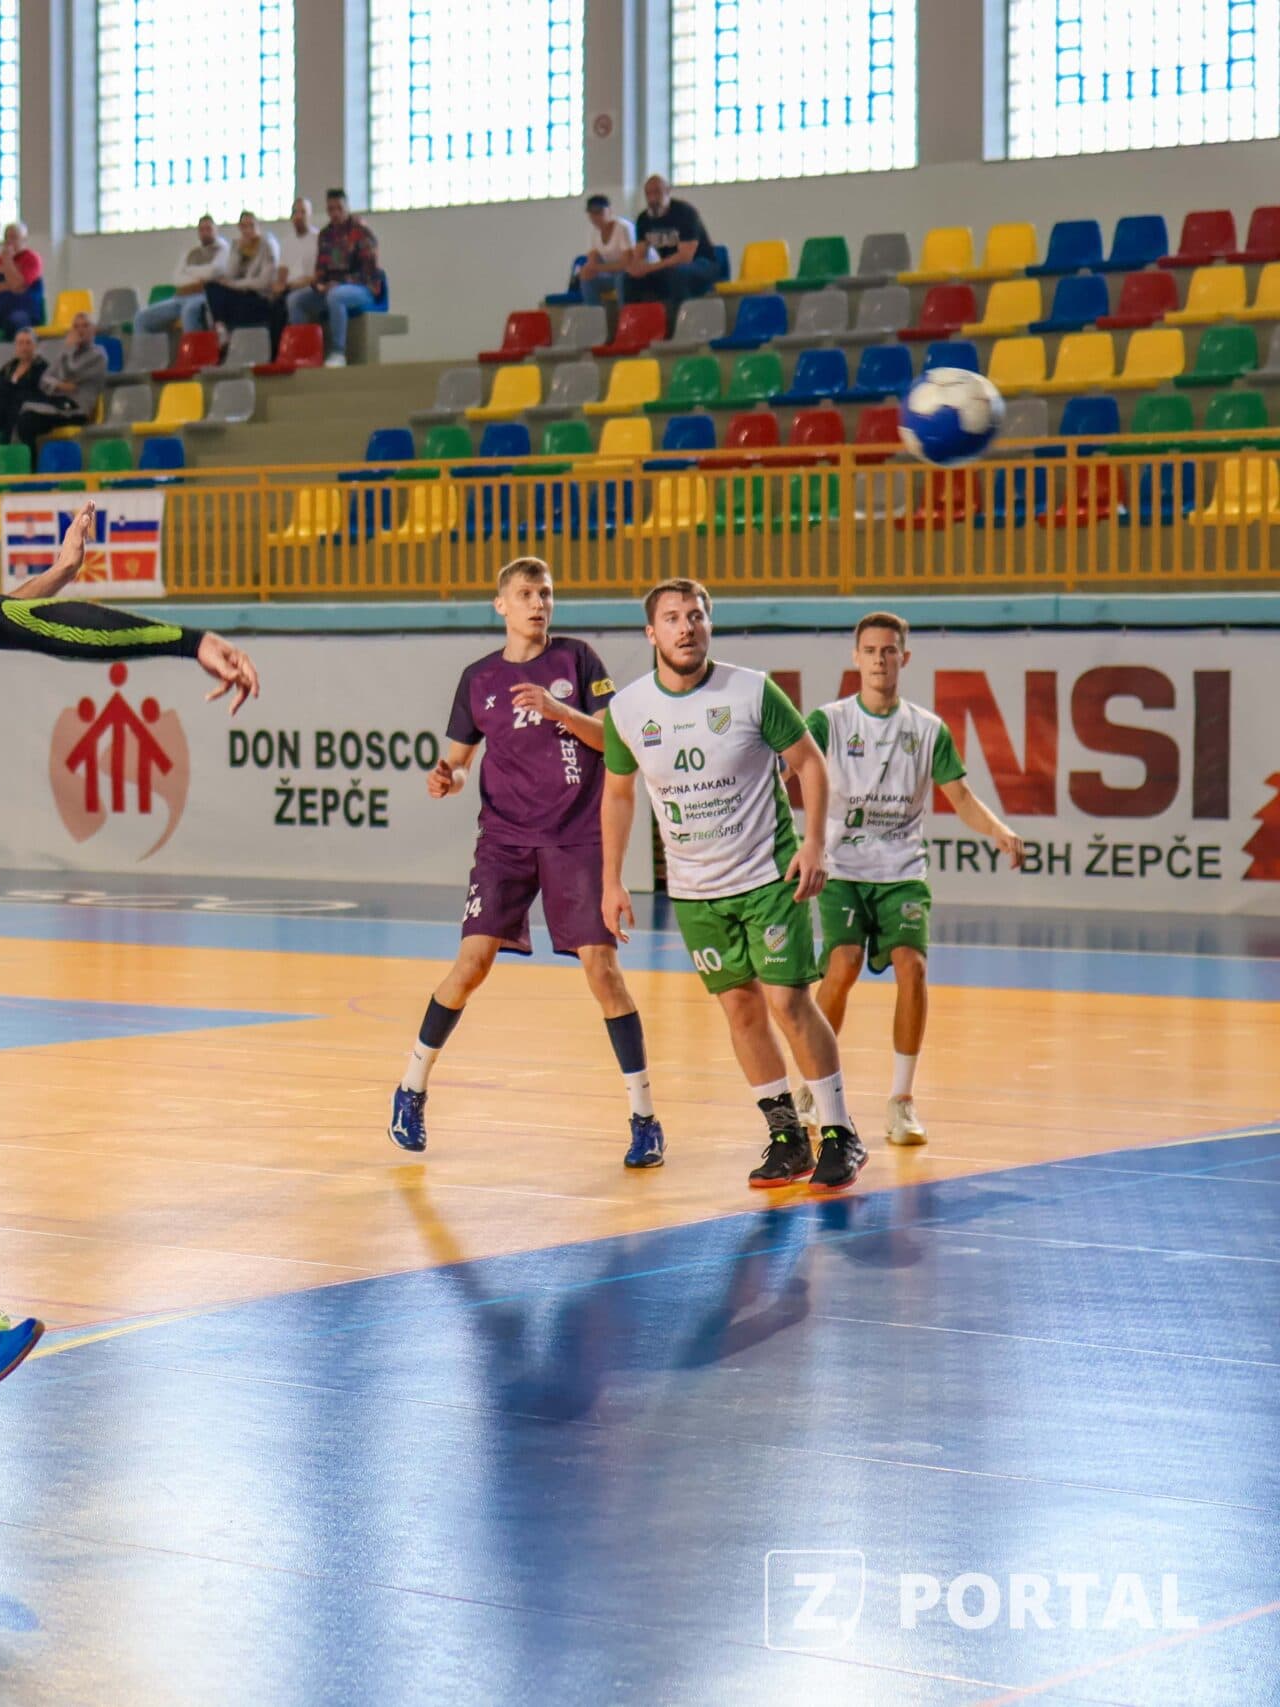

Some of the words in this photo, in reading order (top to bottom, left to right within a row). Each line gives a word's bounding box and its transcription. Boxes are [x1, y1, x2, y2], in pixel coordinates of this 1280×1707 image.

[228, 730, 300, 769] DON
[315, 731, 440, 771] BOSCO
[560, 738, 582, 785] ŽEPČE
[673, 746, 706, 773] 40
[693, 776, 737, 792] KAKANJ
[274, 777, 389, 828] ŽEPČE
[684, 793, 742, 811] Heidelberg
[686, 805, 737, 821] Materials
[1084, 834, 1223, 879] ŽEPČE
[841, 905, 856, 929] 7
[693, 946, 722, 975] 40
